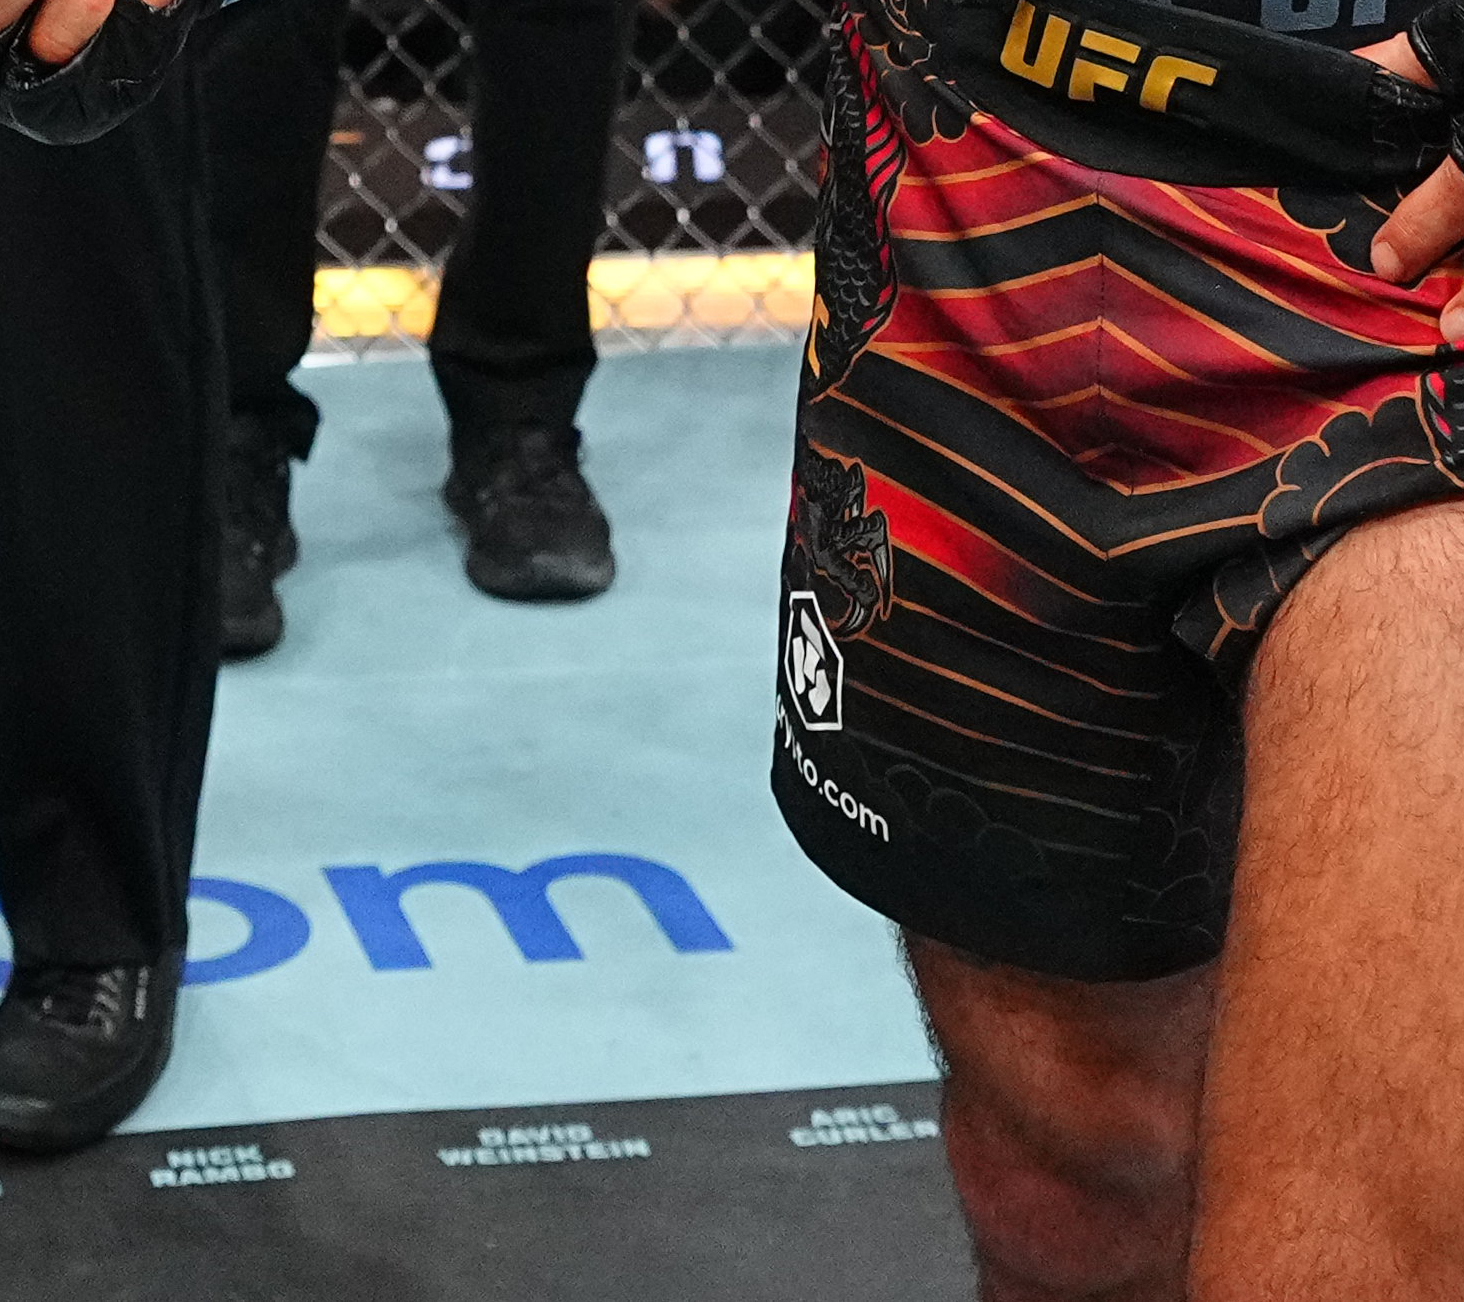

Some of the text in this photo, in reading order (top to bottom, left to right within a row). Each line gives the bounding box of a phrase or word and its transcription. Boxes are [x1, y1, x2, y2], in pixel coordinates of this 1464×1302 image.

[477, 1122, 594, 1147] DAVID
[167, 1144, 264, 1168] NICK
[149, 1159, 296, 1188] RAMBO
